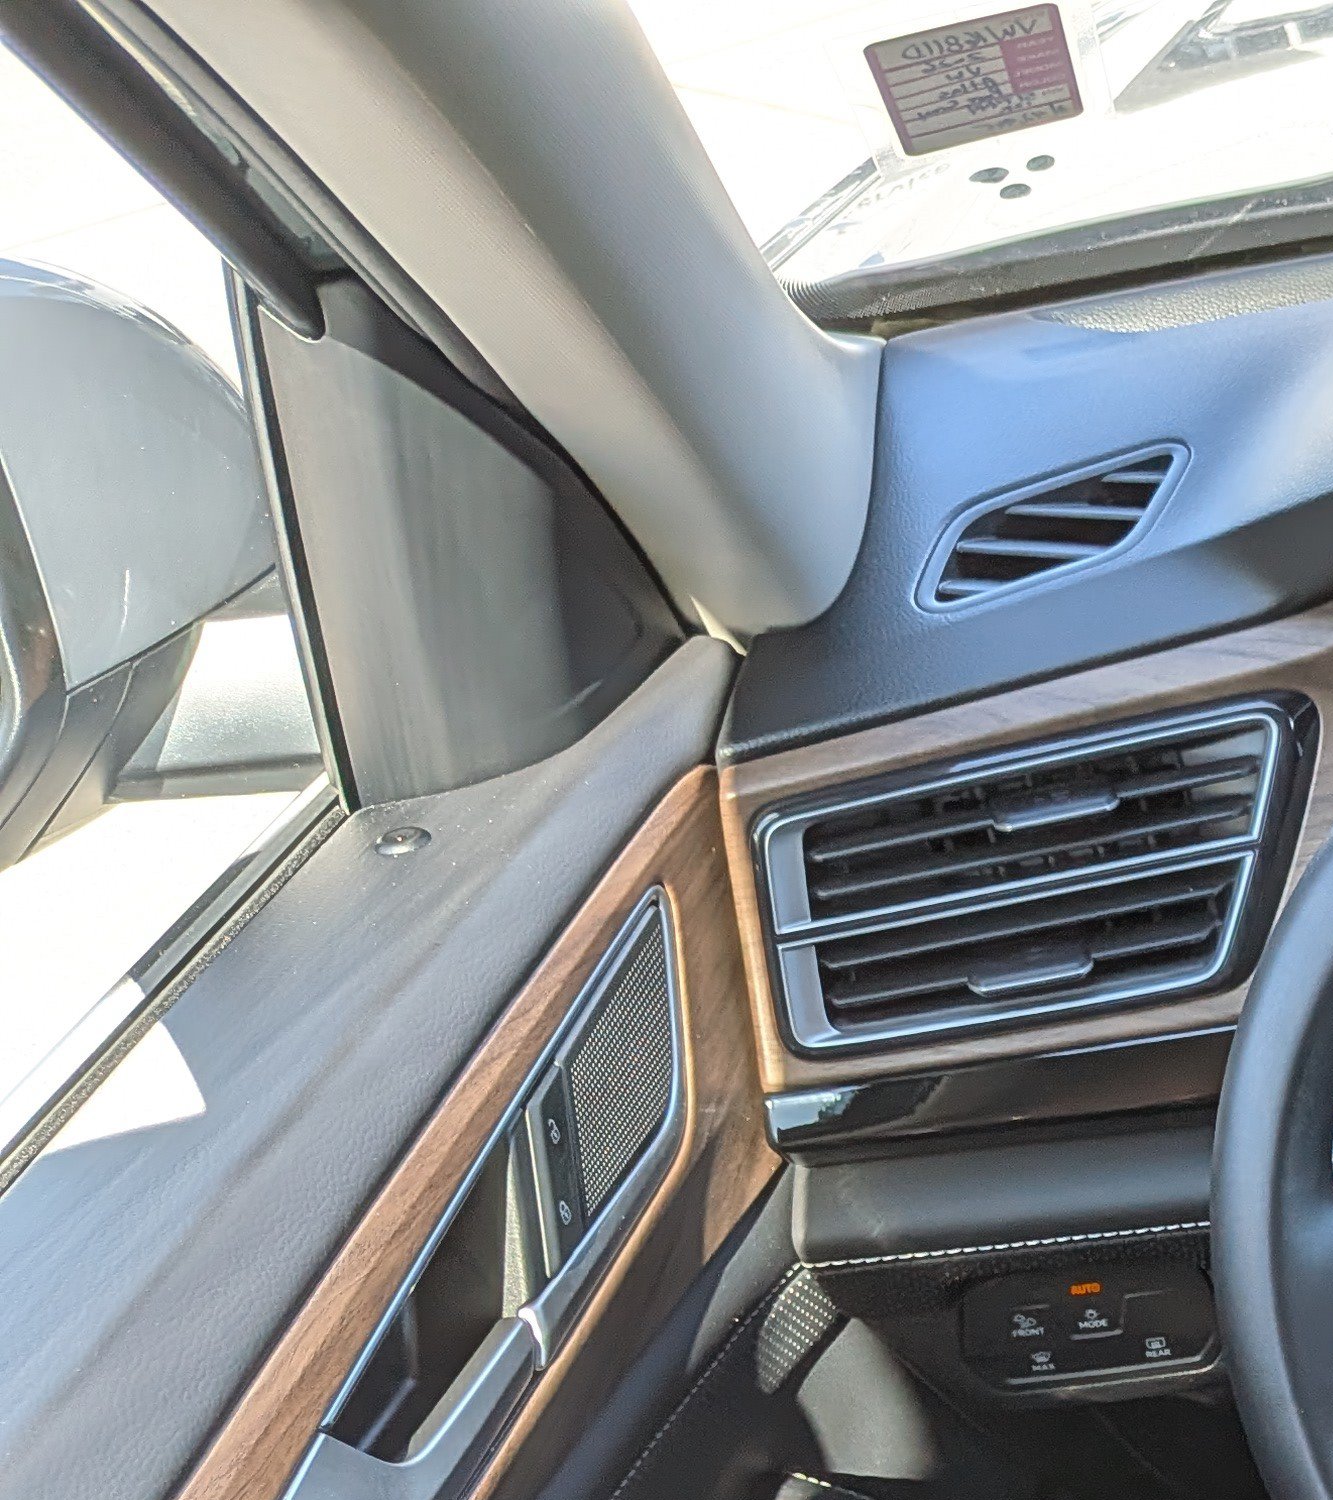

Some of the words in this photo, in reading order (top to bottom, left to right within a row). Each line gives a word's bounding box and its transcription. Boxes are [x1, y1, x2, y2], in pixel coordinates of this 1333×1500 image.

[1070, 1282, 1101, 1296] AUTO
[1078, 1318, 1109, 1330] MODE
[1011, 1326, 1045, 1339] FRONT
